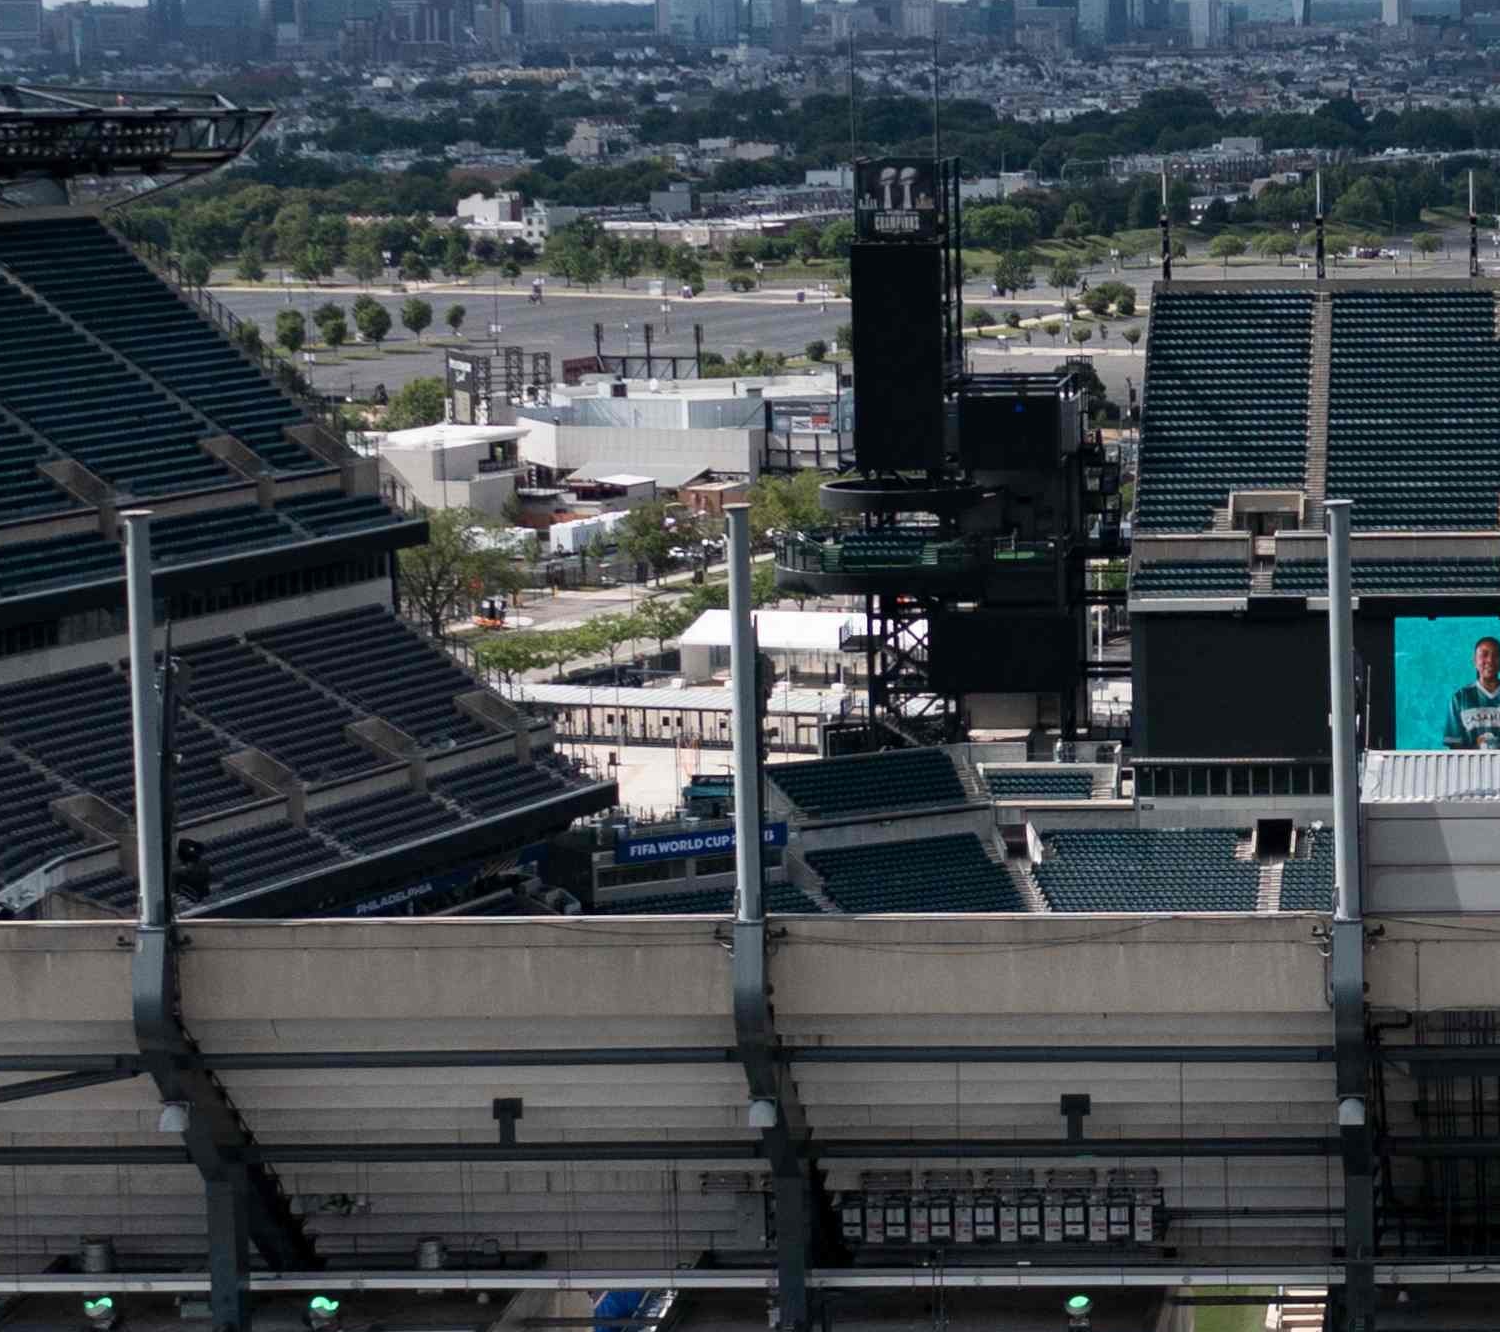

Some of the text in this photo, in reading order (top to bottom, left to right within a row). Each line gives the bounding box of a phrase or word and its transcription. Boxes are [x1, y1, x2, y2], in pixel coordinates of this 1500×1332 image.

[629, 844, 657, 857] FIFA
[658, 837, 704, 854] WORLD
[705, 835, 730, 849] CUP
